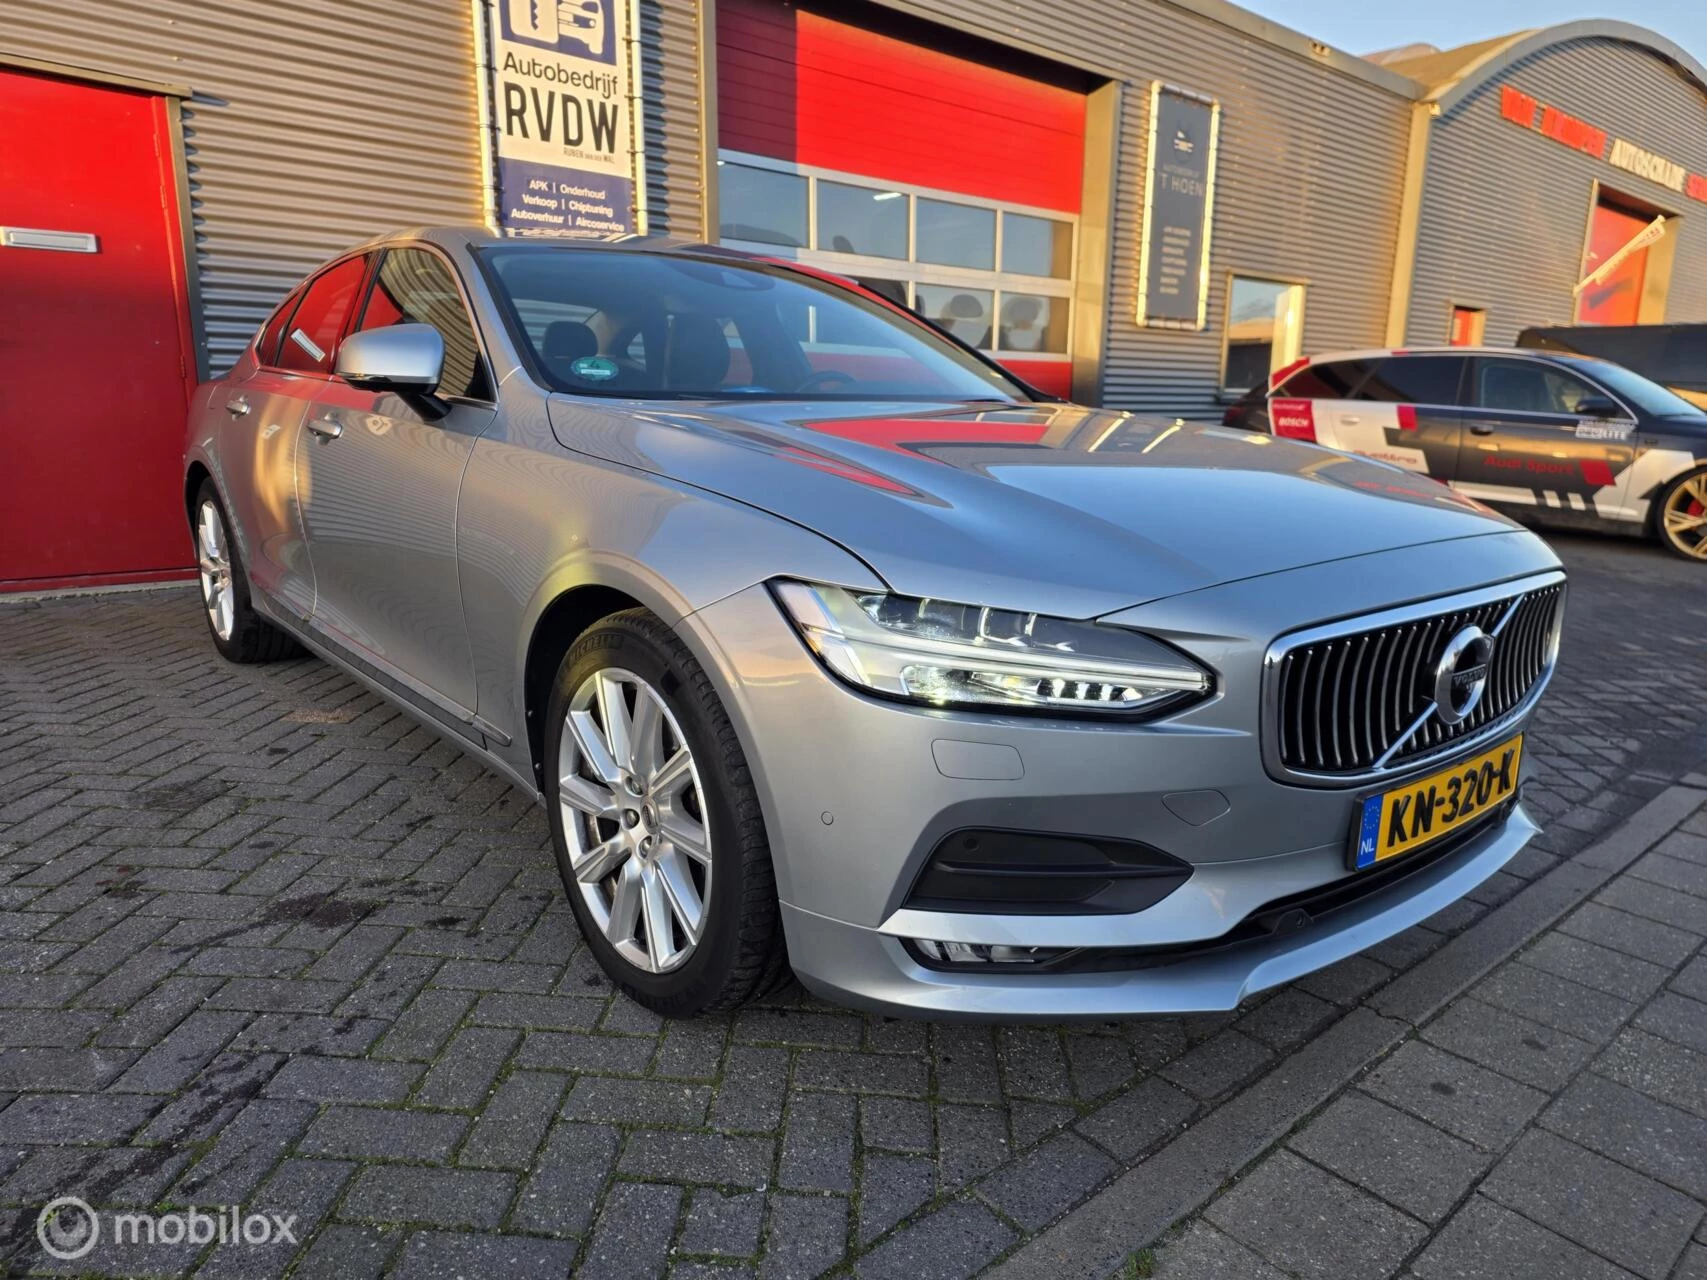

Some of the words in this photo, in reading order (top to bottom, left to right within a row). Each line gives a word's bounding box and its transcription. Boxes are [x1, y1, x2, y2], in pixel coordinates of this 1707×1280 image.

[503, 51, 618, 99] Autobedrijf
[503, 81, 619, 154] RVDW
[529, 180, 548, 192] APK
[560, 184, 606, 199] Onderhoud
[522, 194, 558, 209] Verkoop
[569, 201, 614, 218] Chiptuning
[511, 209, 565, 224] Autoverhuur
[576, 217, 625, 232] Aircoservice
[1483, 455, 1521, 469] Audi
[1526, 458, 1574, 475] Sport
[1387, 749, 1514, 847] KN-320-K
[1361, 839, 1375, 855] NL
